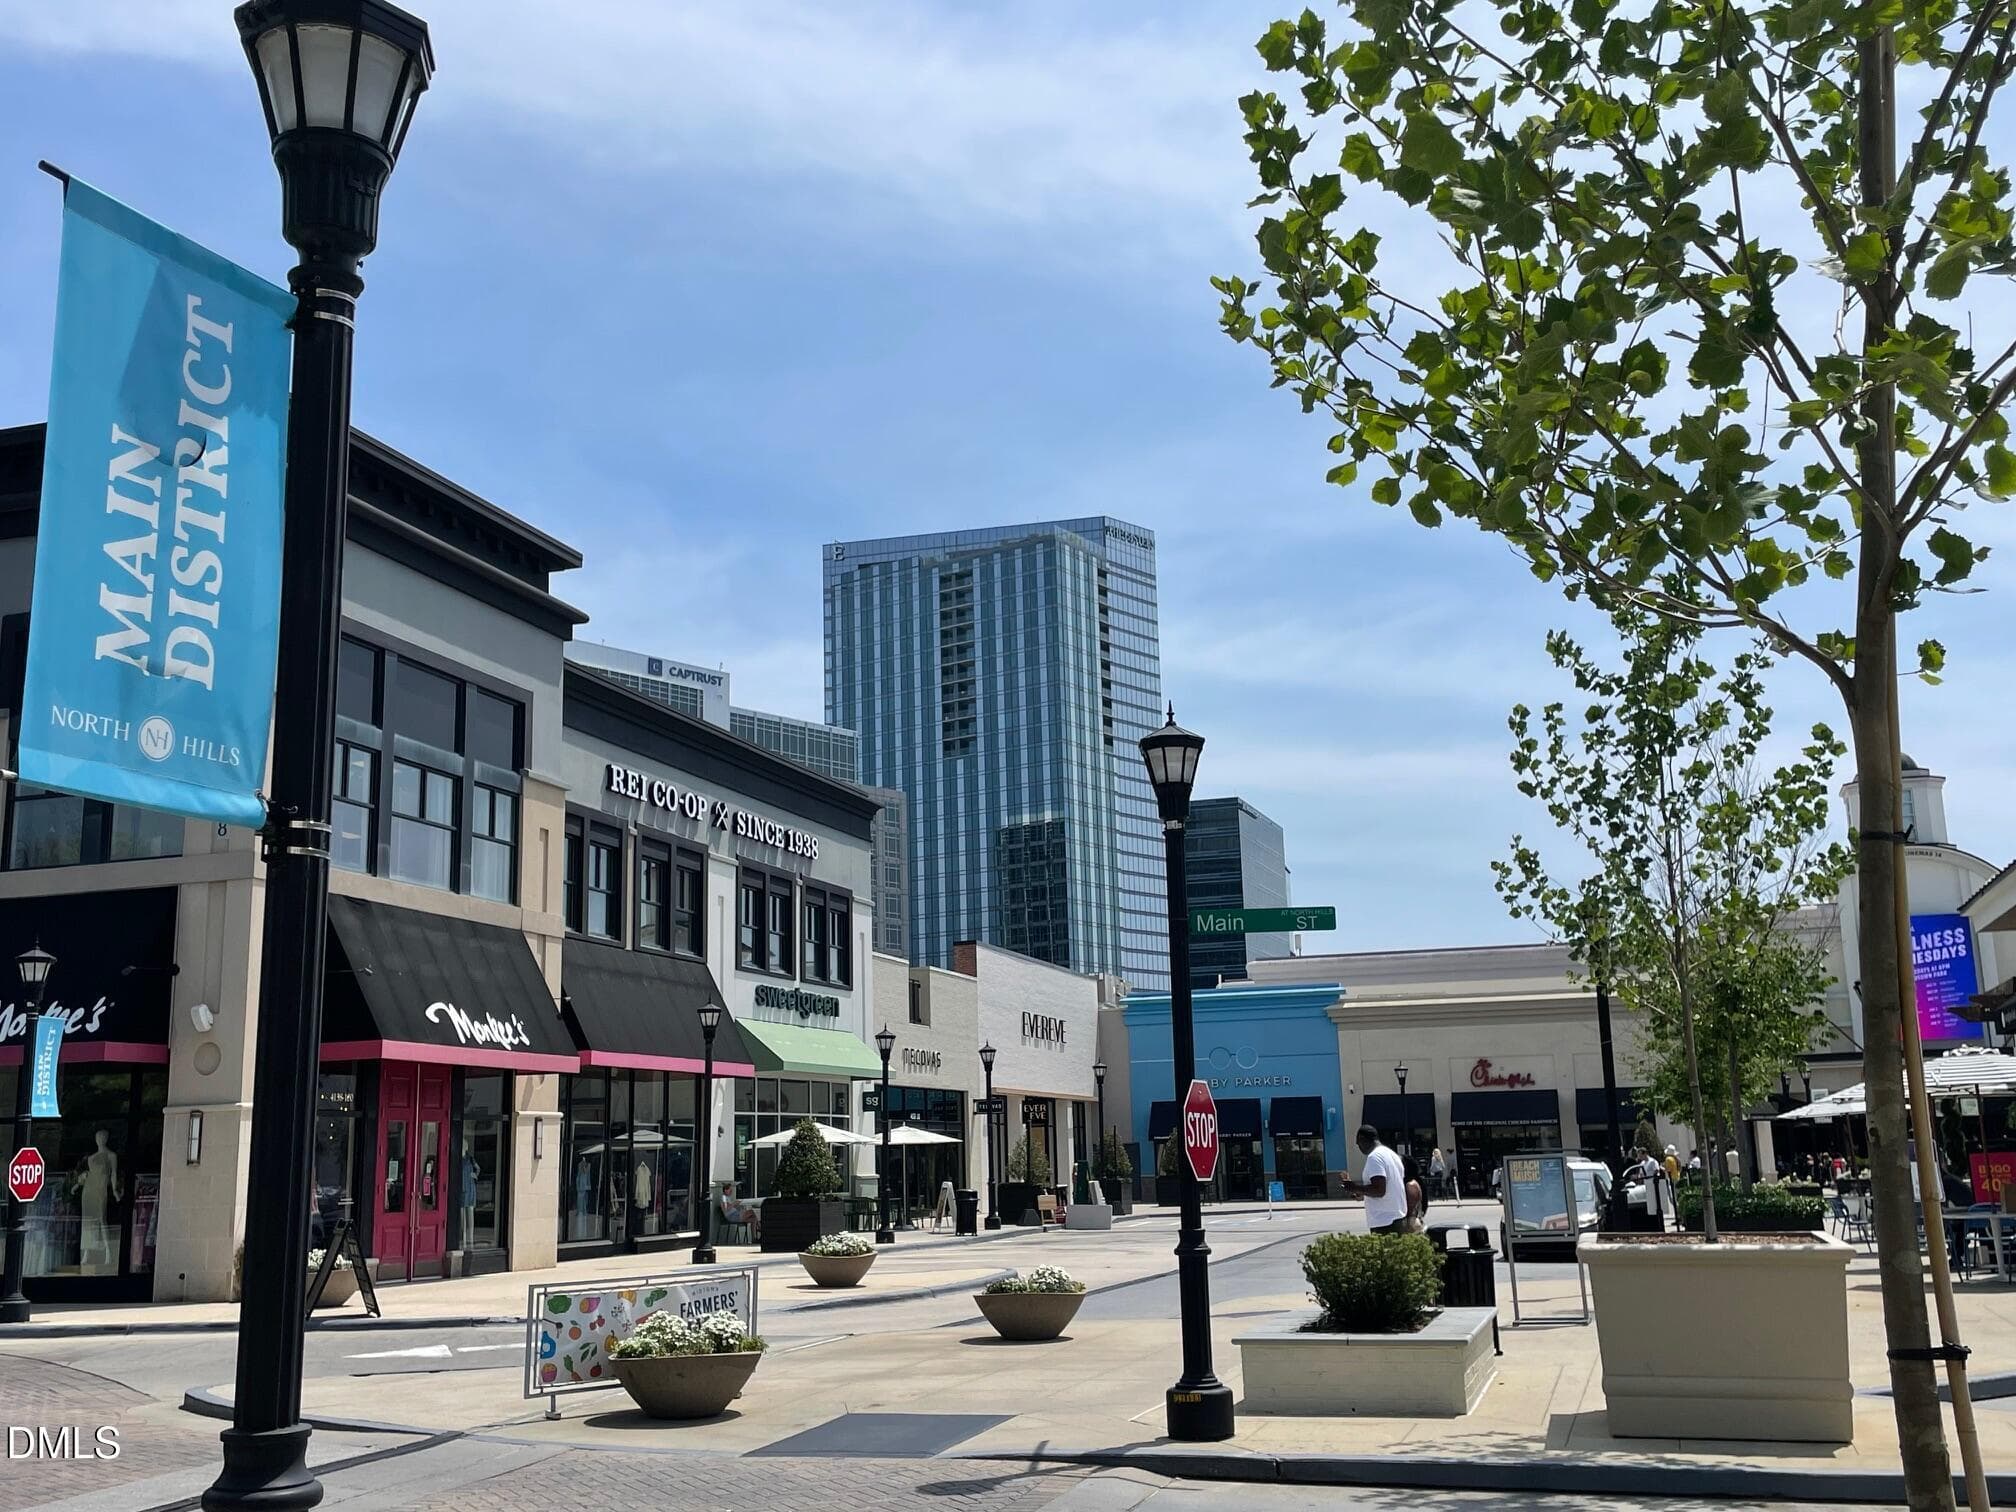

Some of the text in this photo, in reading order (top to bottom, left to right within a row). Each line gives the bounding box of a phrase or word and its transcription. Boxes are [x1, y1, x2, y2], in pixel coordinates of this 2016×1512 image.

[163, 294, 235, 691] DISTRICT
[95, 423, 161, 679] MAIN
[669, 667, 724, 687] CAPTRUST
[51, 705, 130, 742] NORTH
[182, 735, 241, 767] HILLS
[610, 763, 819, 860] REI CO-OP SINCE 1938
[1197, 913, 1318, 932] Main ST
[755, 984, 840, 1019] sweetgreen
[425, 1002, 530, 1050] Monkee's
[1022, 1011, 1067, 1044] EVEREVE
[904, 1048, 941, 1068] TECOVAS
[1235, 1076, 1292, 1087] PARKER
[865, 1096, 879, 1106] sg
[1023, 1104, 1047, 1113] EVER
[1030, 1112, 1047, 1120] EVE
[1187, 1111, 1216, 1149] STOP
[12, 1165, 41, 1185] STOP
[680, 1291, 738, 1318] FARMERS'
